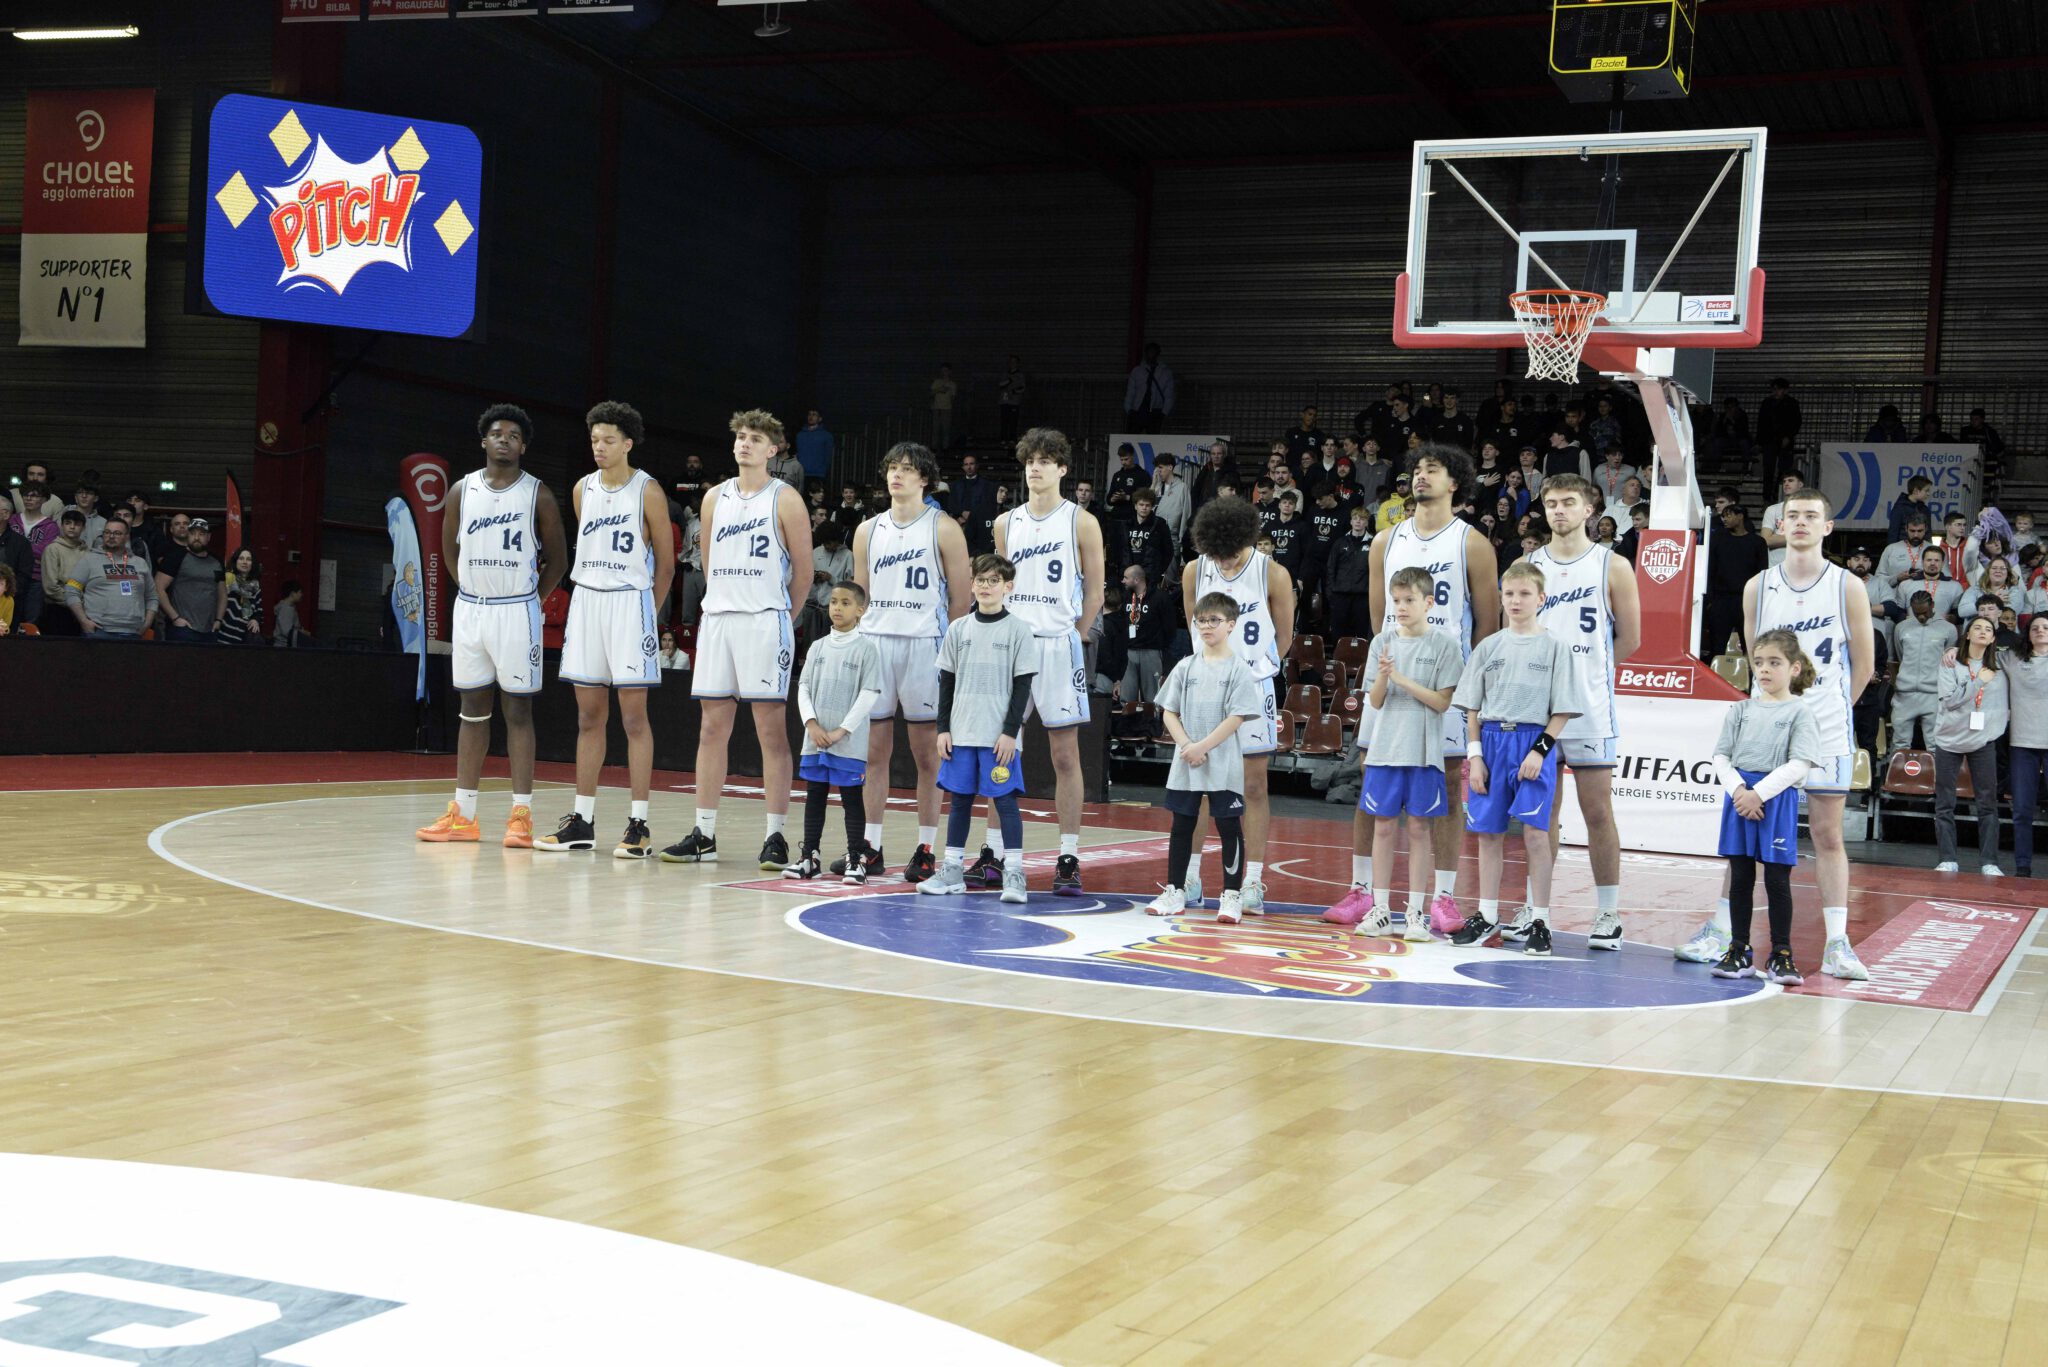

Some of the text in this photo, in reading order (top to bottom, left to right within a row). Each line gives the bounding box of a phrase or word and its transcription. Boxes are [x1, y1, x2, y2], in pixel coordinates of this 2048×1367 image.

[325, 3, 351, 13] BILBA
[396, 0, 445, 10] RIGAUDEAU
[1593, 58, 1624, 68] Bodet
[42, 185, 134, 201] agglomération
[270, 173, 419, 271] PITCH
[40, 259, 132, 280] SUPPORTER
[1921, 453, 1962, 464] Région
[1932, 489, 1960, 499] de la
[467, 513, 523, 535] CHORALE
[1259, 512, 1276, 520] EAC
[1314, 516, 1338, 527] DEAC
[502, 529, 522, 552] 14
[716, 518, 768, 542] CHORALE
[611, 531, 634, 554] 13
[749, 535, 769, 558] 12
[1047, 559, 1063, 583] 9
[1641, 550, 1684, 571] CHOLET
[905, 566, 929, 590] 10
[1434, 580, 1451, 606] 6
[1536, 586, 1597, 617] HORALE
[1126, 604, 1149, 614] DAC
[1580, 606, 1597, 633] 5
[1244, 621, 1260, 646] 8
[1814, 638, 1833, 664] 4
[1619, 670, 1687, 688] Betclic
[1610, 787, 1715, 803] NERGIE SYSTÈMES
